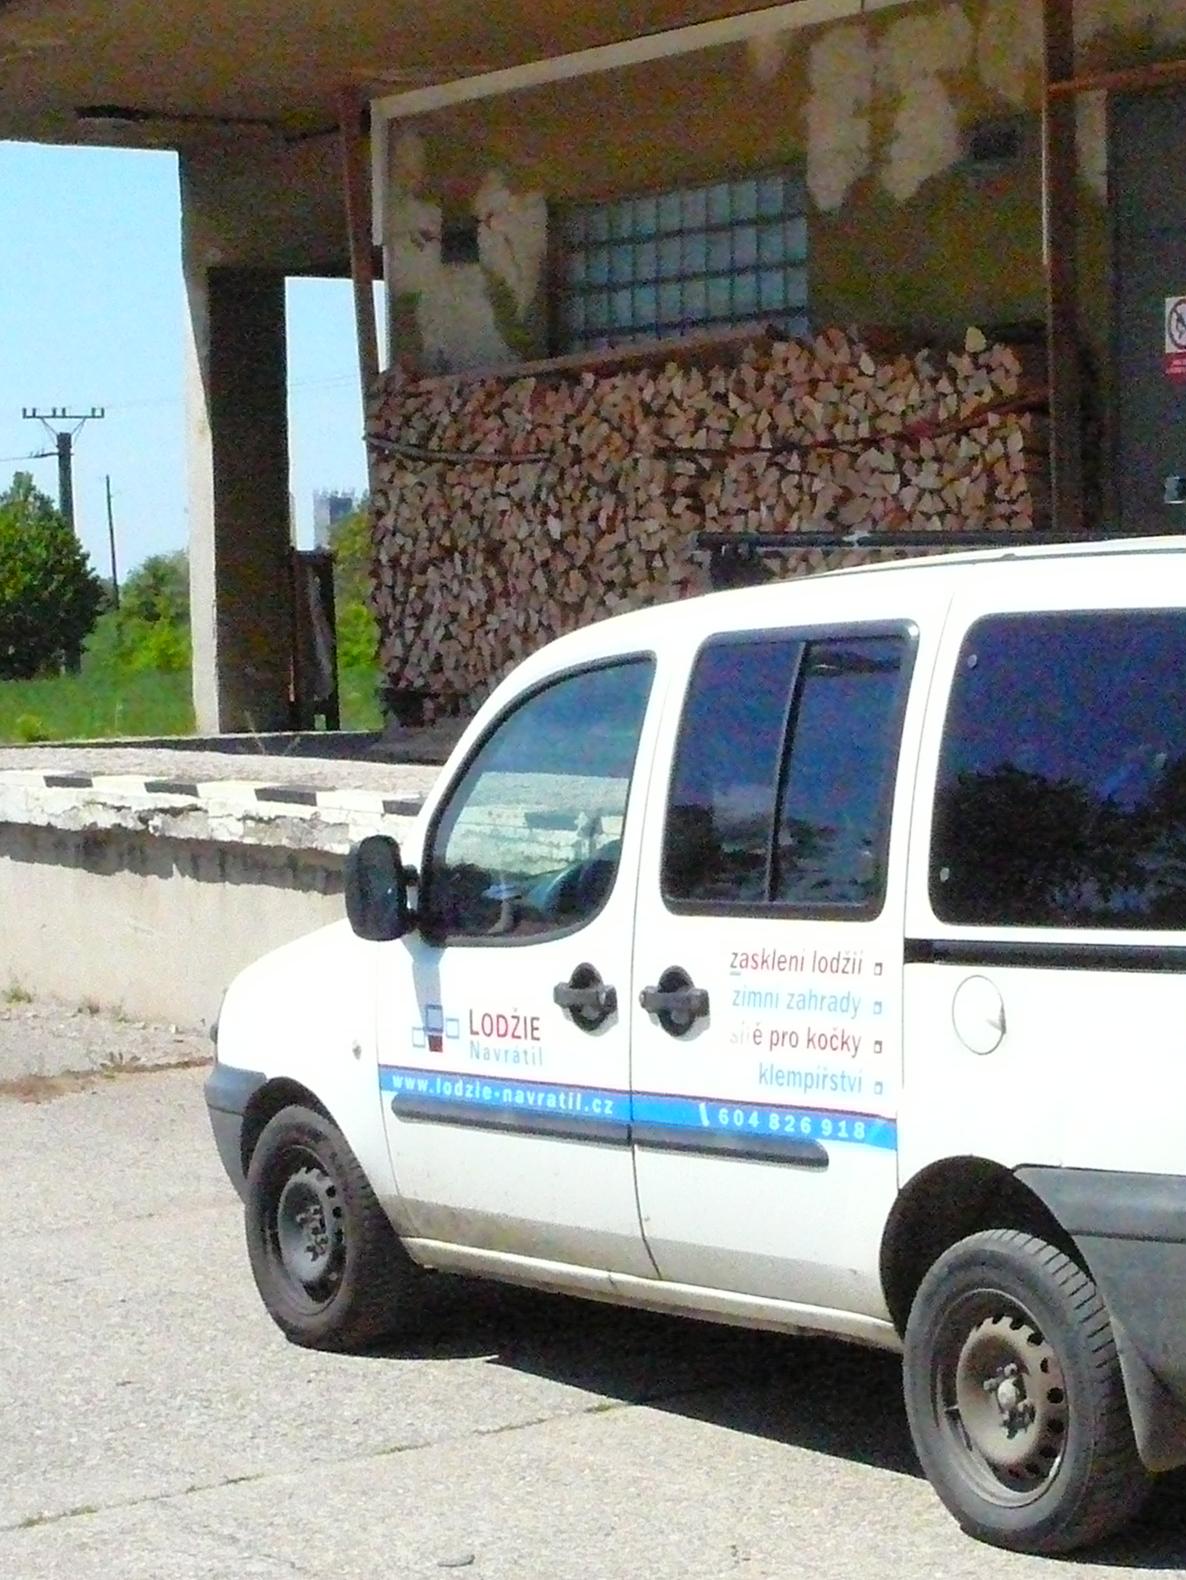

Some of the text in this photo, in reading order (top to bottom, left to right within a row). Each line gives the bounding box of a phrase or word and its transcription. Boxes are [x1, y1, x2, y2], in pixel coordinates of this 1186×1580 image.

[786, 989, 861, 1019] zahrady
[769, 1028, 799, 1052] pro
[806, 1026, 861, 1059] kočky
[391, 1074, 613, 1115] www.lodzie-navratil.cz
[718, 1107, 866, 1139] 604 826 918
